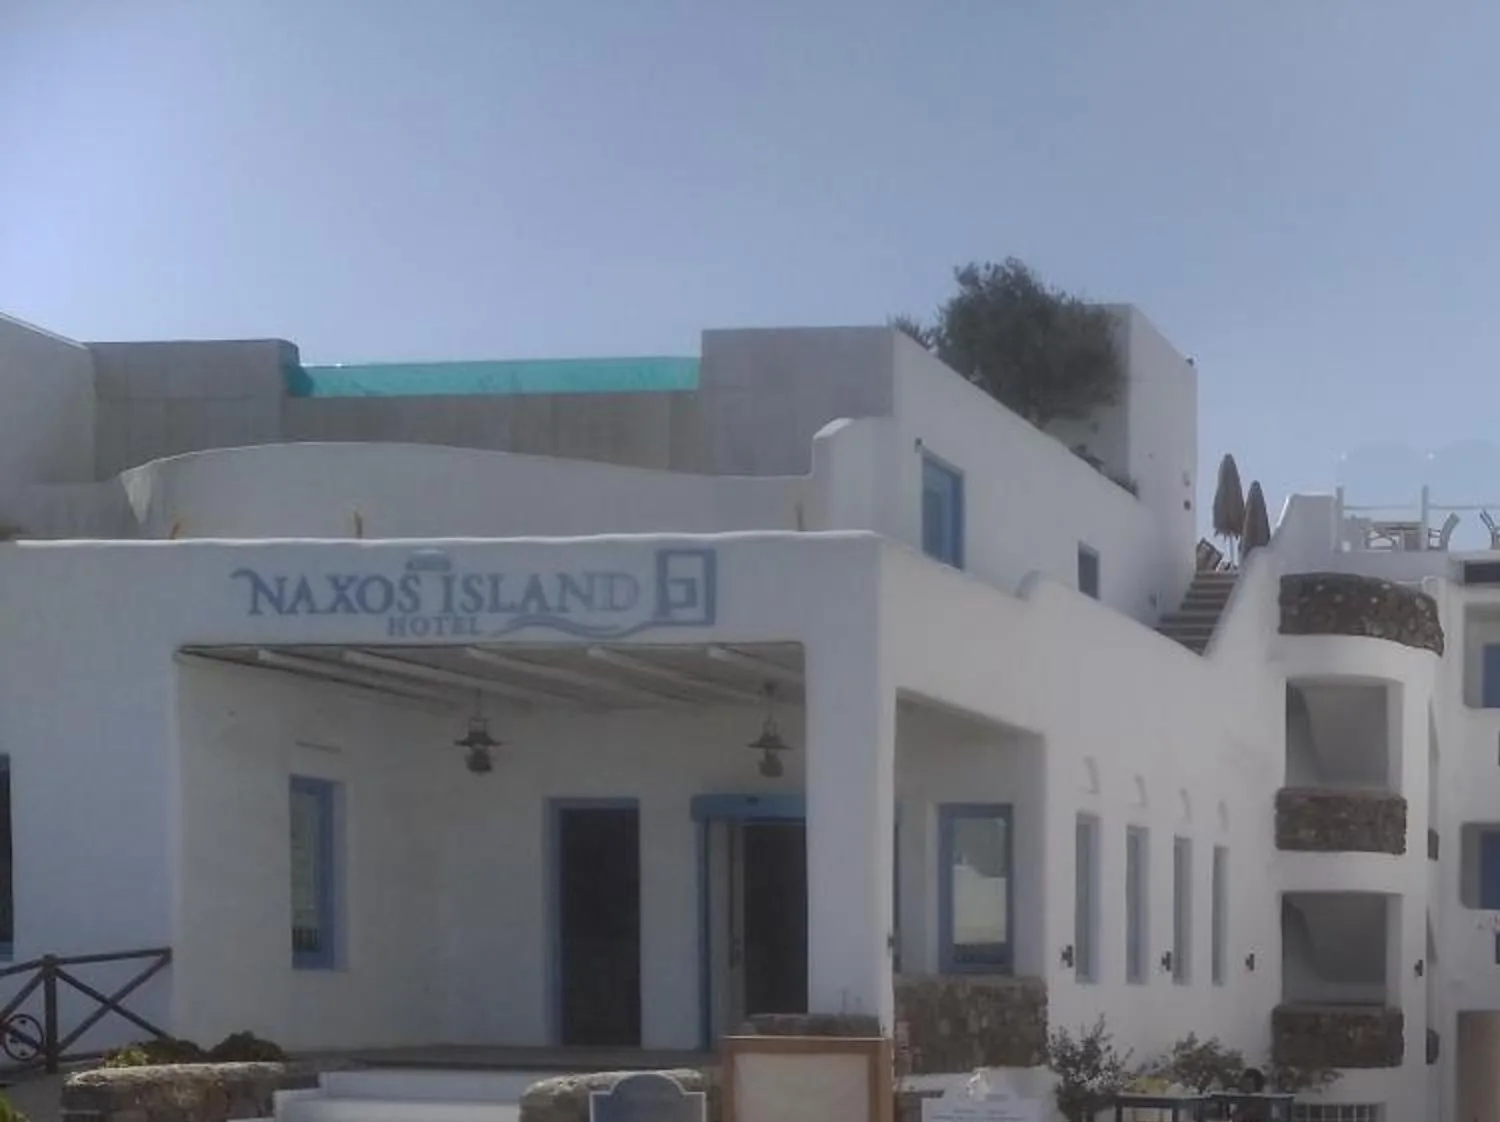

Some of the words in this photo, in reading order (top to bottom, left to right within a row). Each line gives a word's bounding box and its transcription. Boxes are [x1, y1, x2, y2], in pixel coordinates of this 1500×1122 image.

[231, 567, 423, 616] NAXOS
[442, 571, 640, 615] ISLAND
[387, 616, 482, 637] HOTEL
